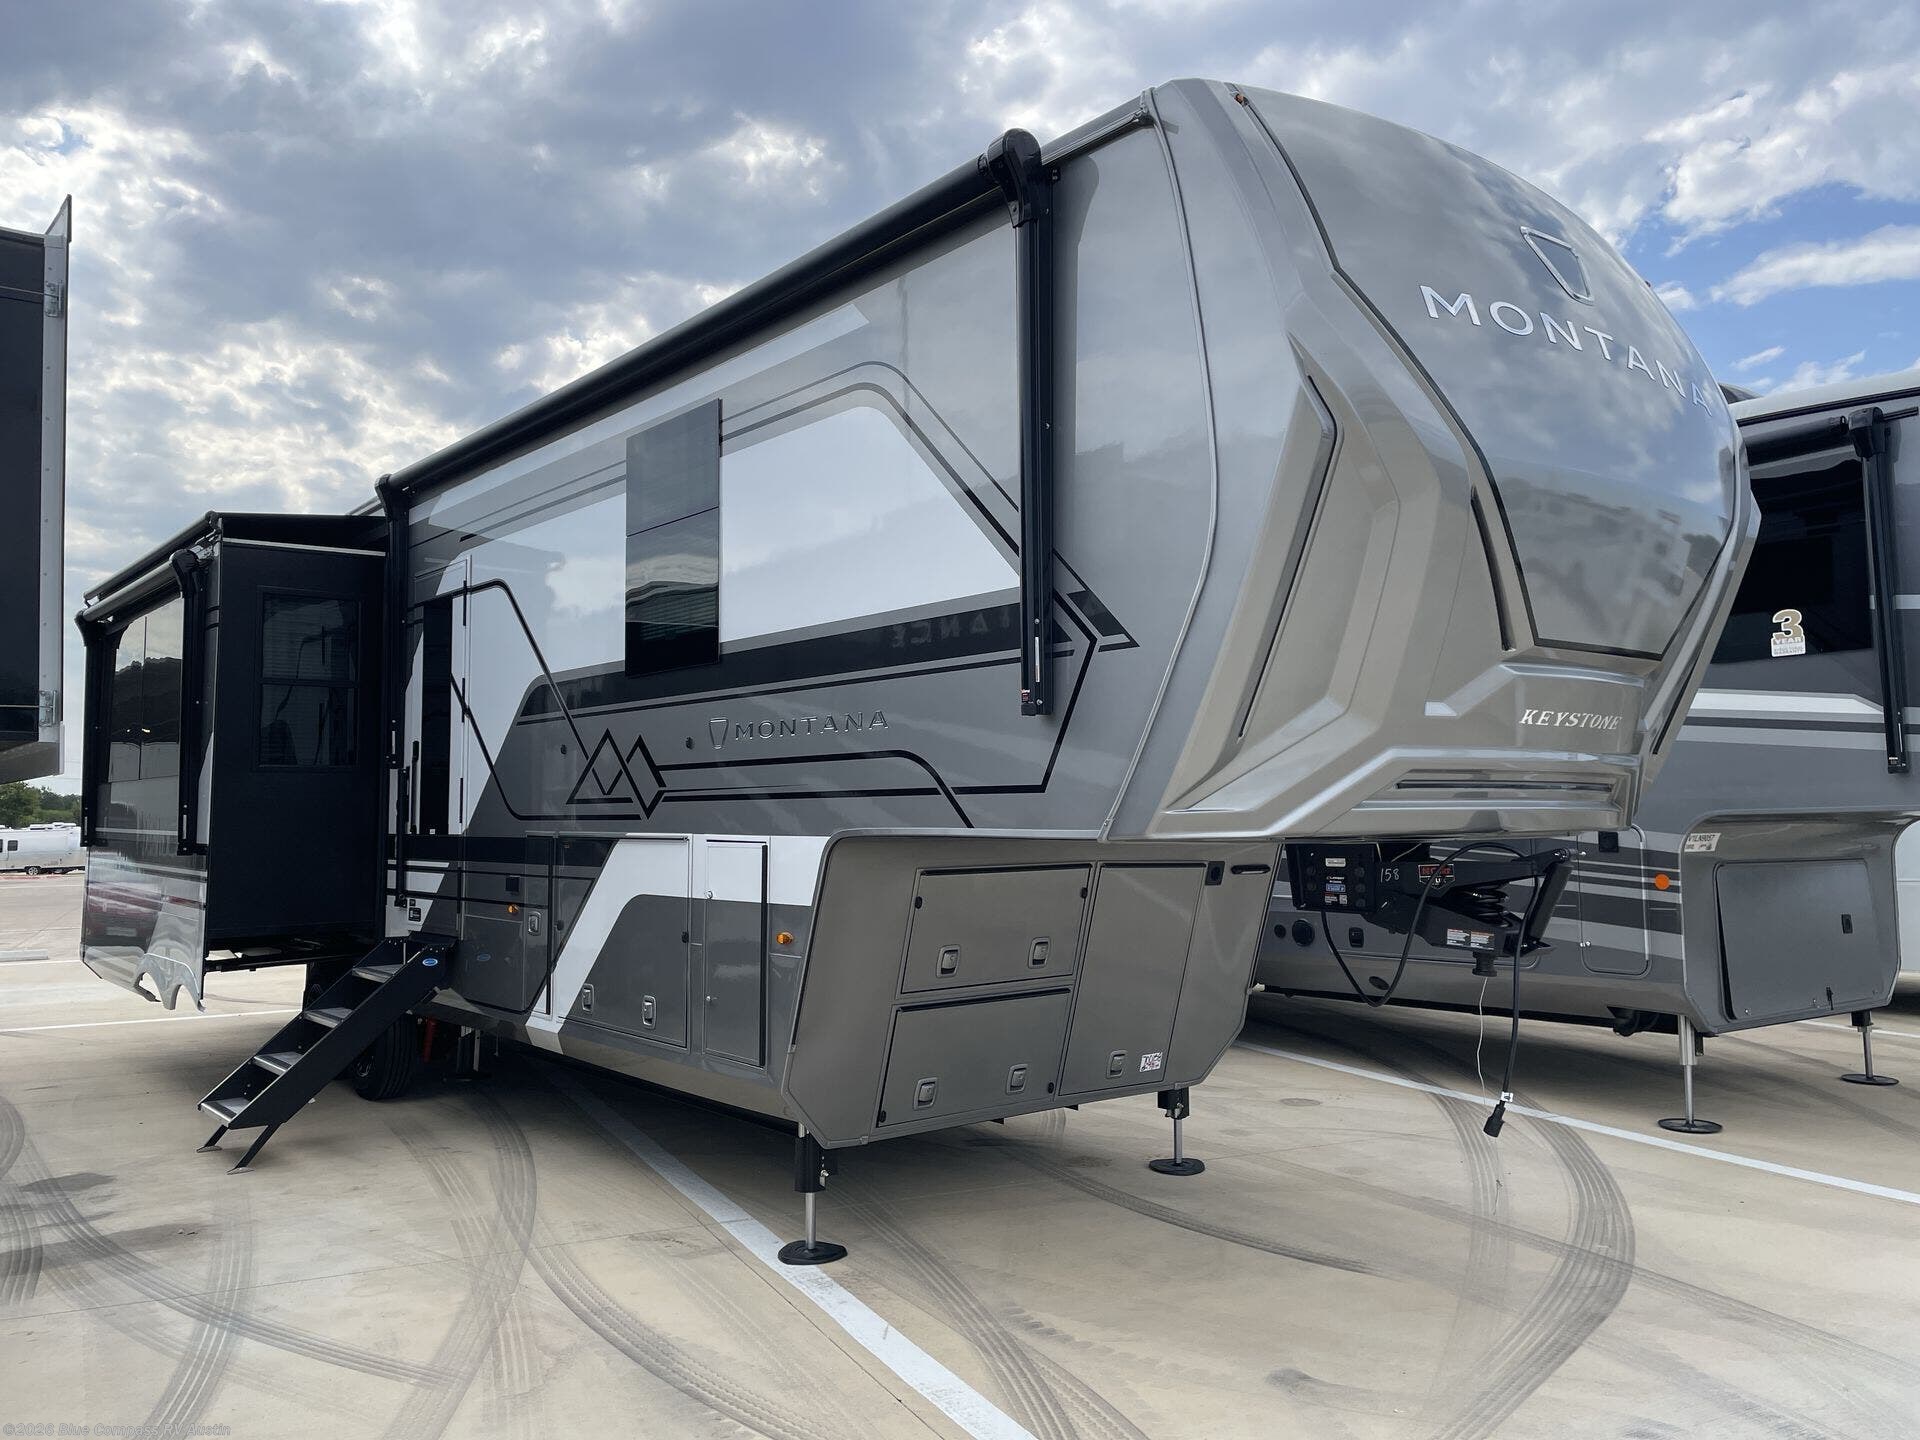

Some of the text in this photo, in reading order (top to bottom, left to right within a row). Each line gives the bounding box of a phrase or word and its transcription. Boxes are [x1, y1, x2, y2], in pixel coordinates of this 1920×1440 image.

[1420, 285, 1713, 417] MONTANA
[1772, 609, 1803, 639] 3
[1774, 636, 1803, 645] YEAR
[735, 709, 890, 741] MONTANA
[1519, 709, 1623, 730] KEYSTONE
[1380, 867, 1400, 883] 158
